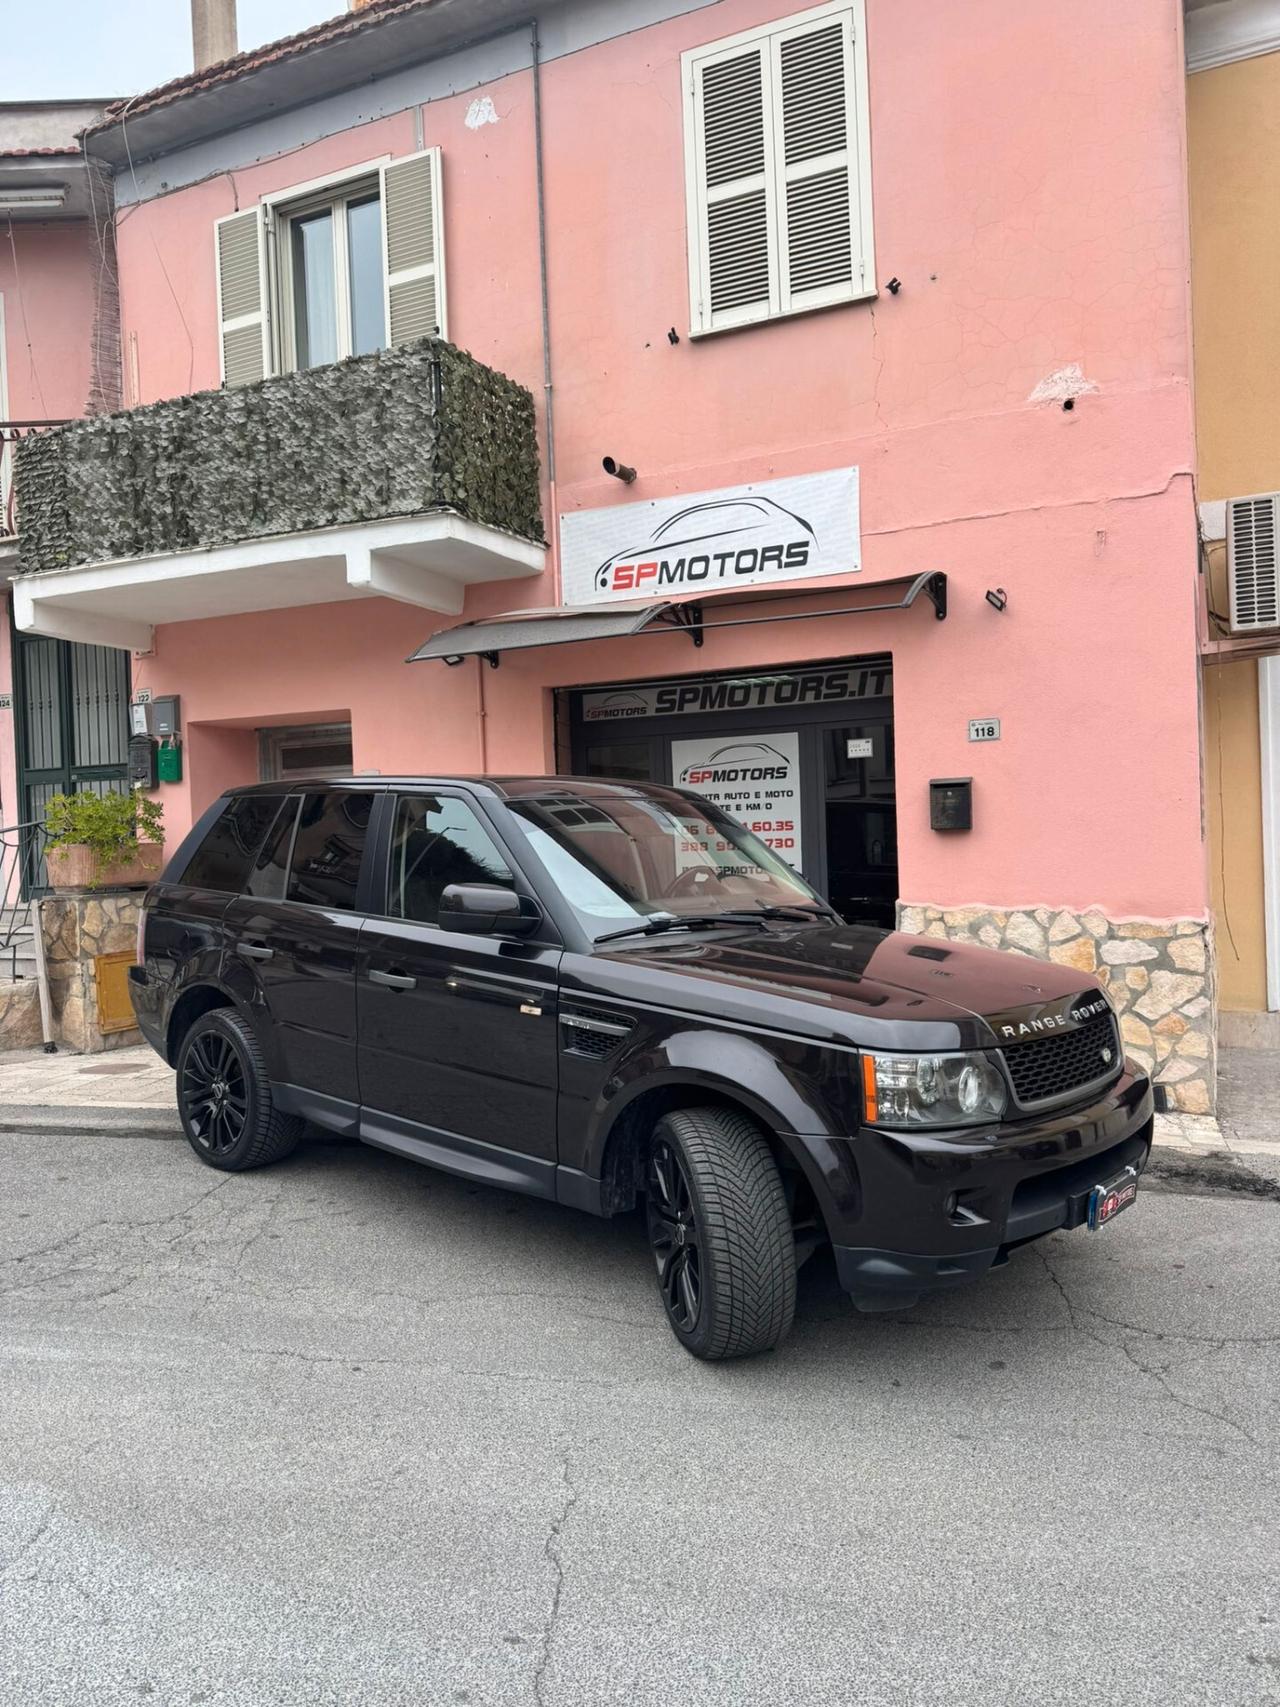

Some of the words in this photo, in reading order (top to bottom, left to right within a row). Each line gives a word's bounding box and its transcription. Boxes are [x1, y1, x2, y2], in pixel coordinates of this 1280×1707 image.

[612, 541, 810, 590] SPMOTORS
[655, 670, 892, 714] SPMOTORS.IT
[590, 707, 647, 720] SPMOTORS
[975, 727, 994, 737] 118
[689, 766, 788, 784] SPMOTORS
[724, 791, 750, 800] AUTO
[755, 791, 761, 799] E
[765, 790, 794, 799] MOTO
[735, 803, 742, 811] E
[764, 838, 795, 849] 730
[1001, 1014, 1066, 1038] RANGE
[1071, 999, 1109, 1021] ROVER
